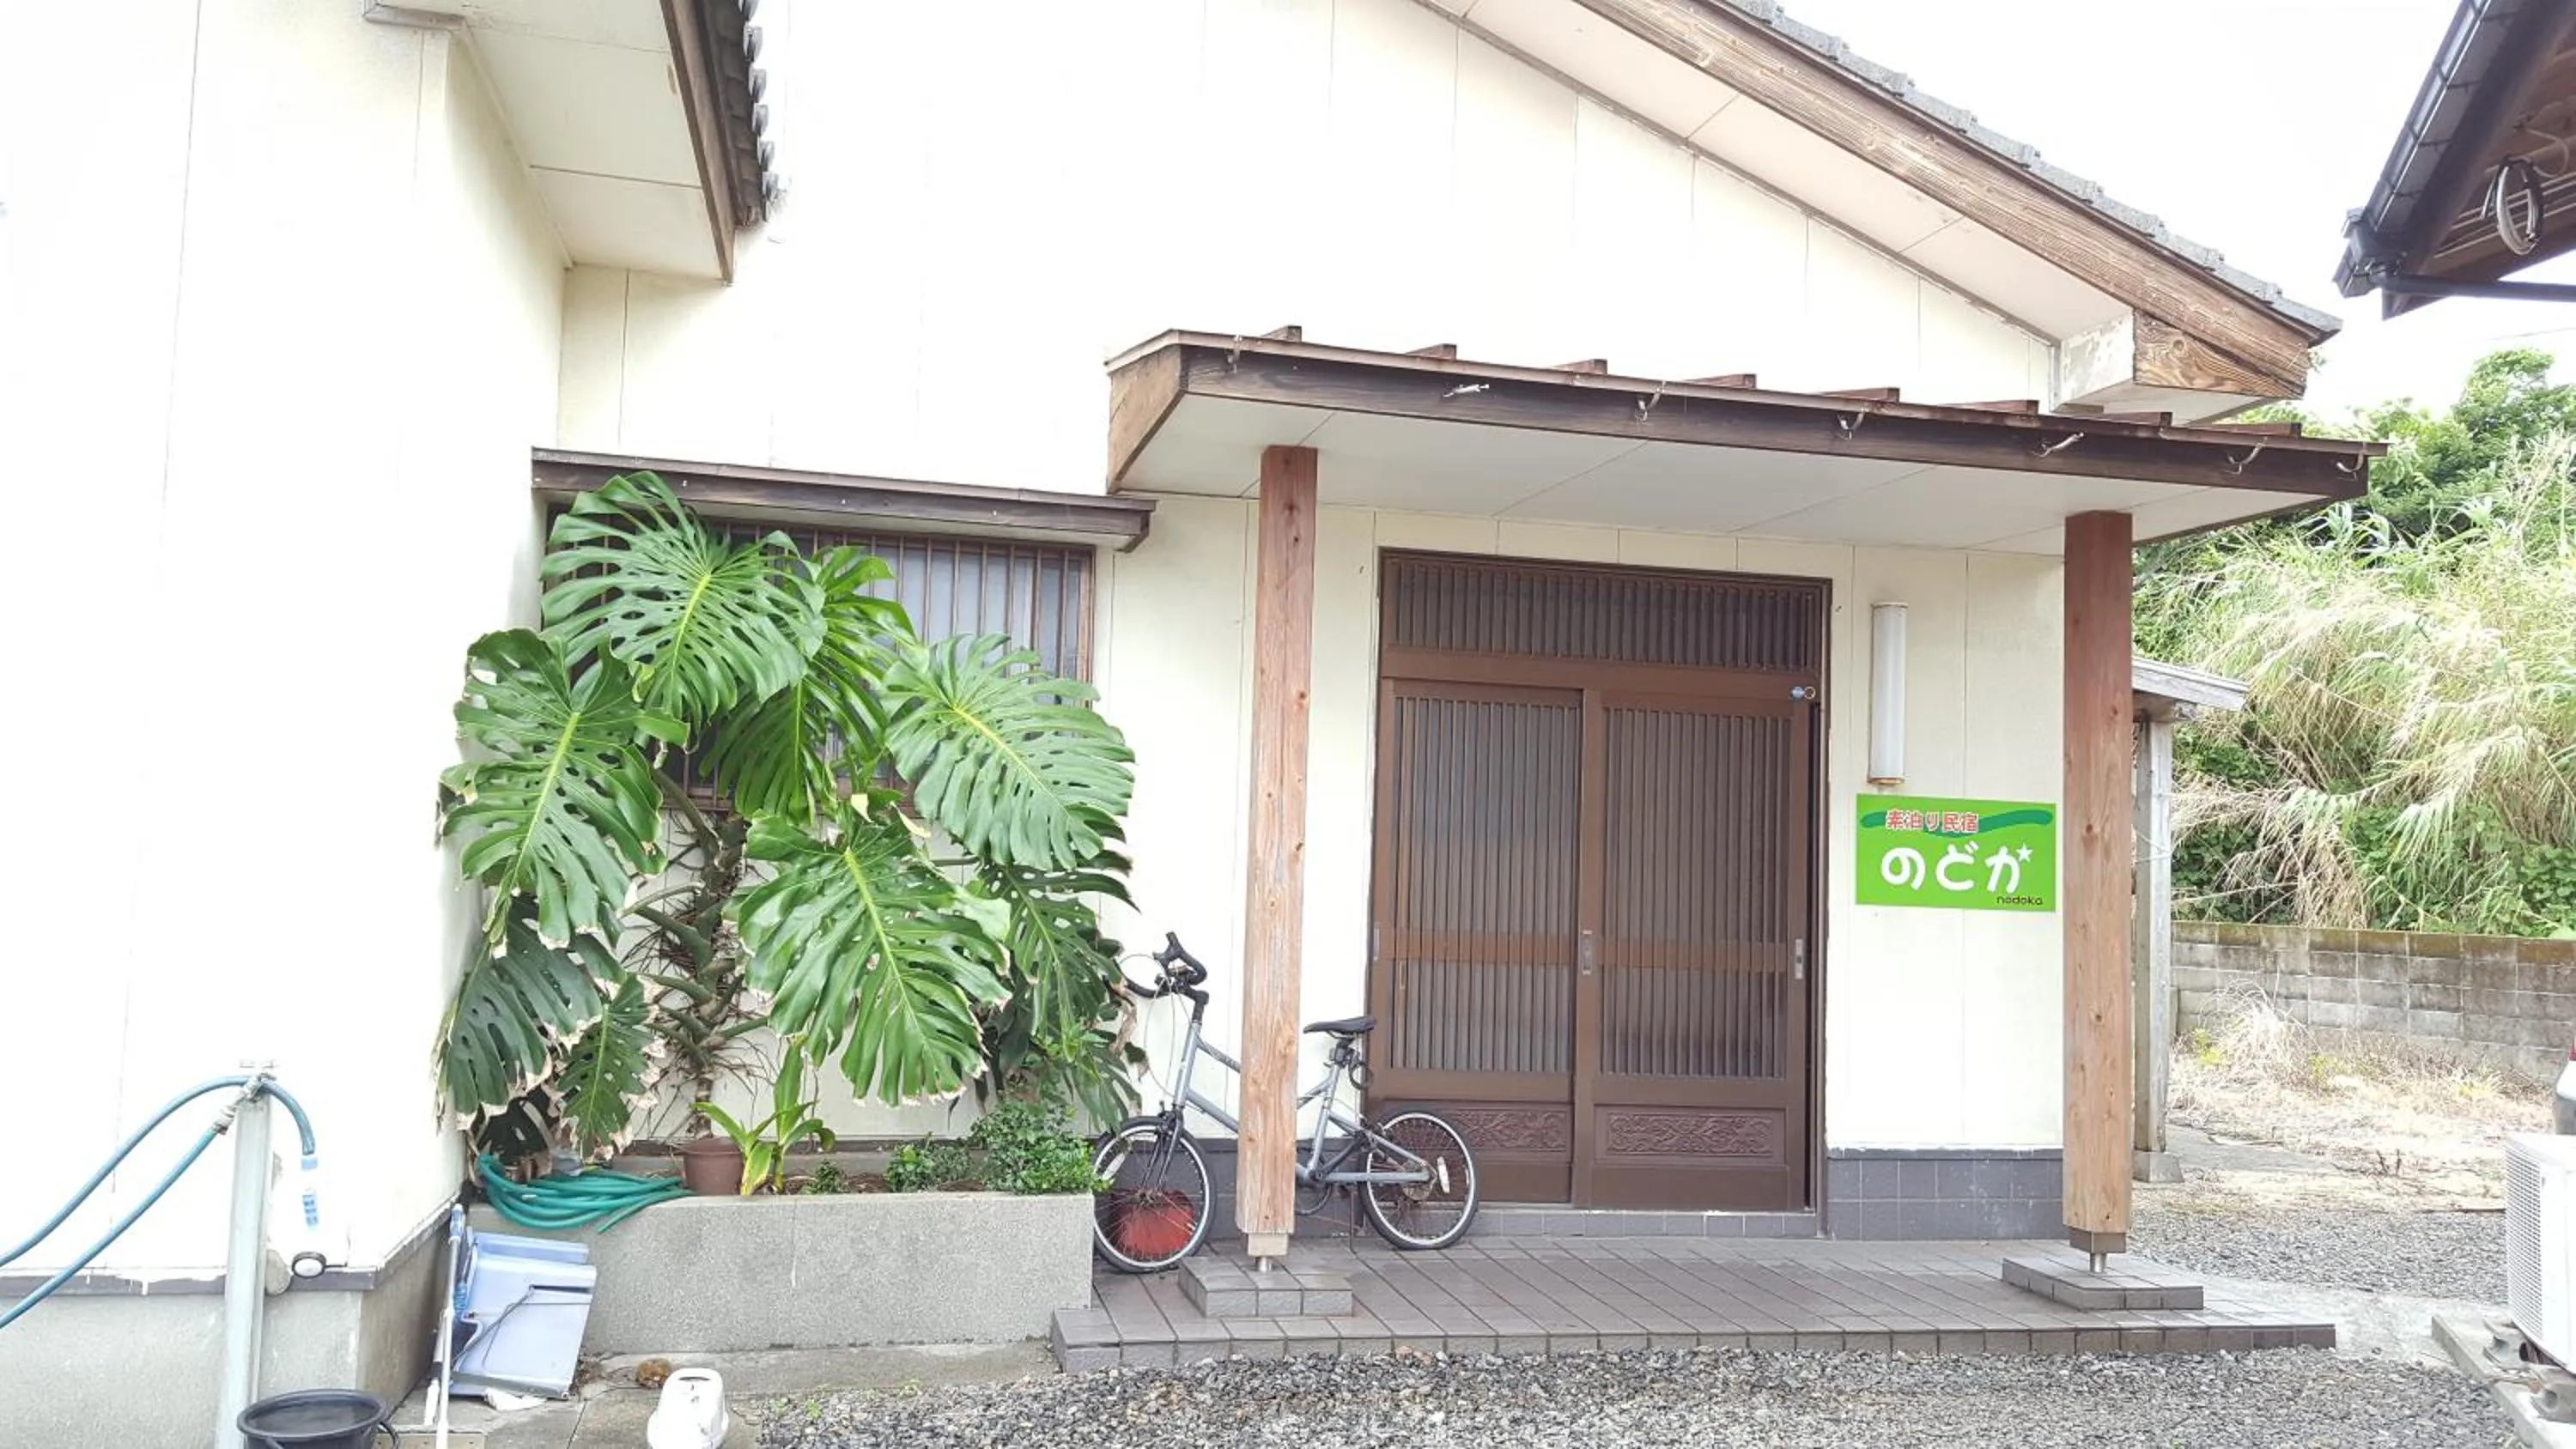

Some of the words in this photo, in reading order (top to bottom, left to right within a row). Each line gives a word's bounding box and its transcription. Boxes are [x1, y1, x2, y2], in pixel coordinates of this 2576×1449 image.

[1886, 809, 1978, 833] 素泊り民宿
[1996, 895, 2044, 906] nodoka
